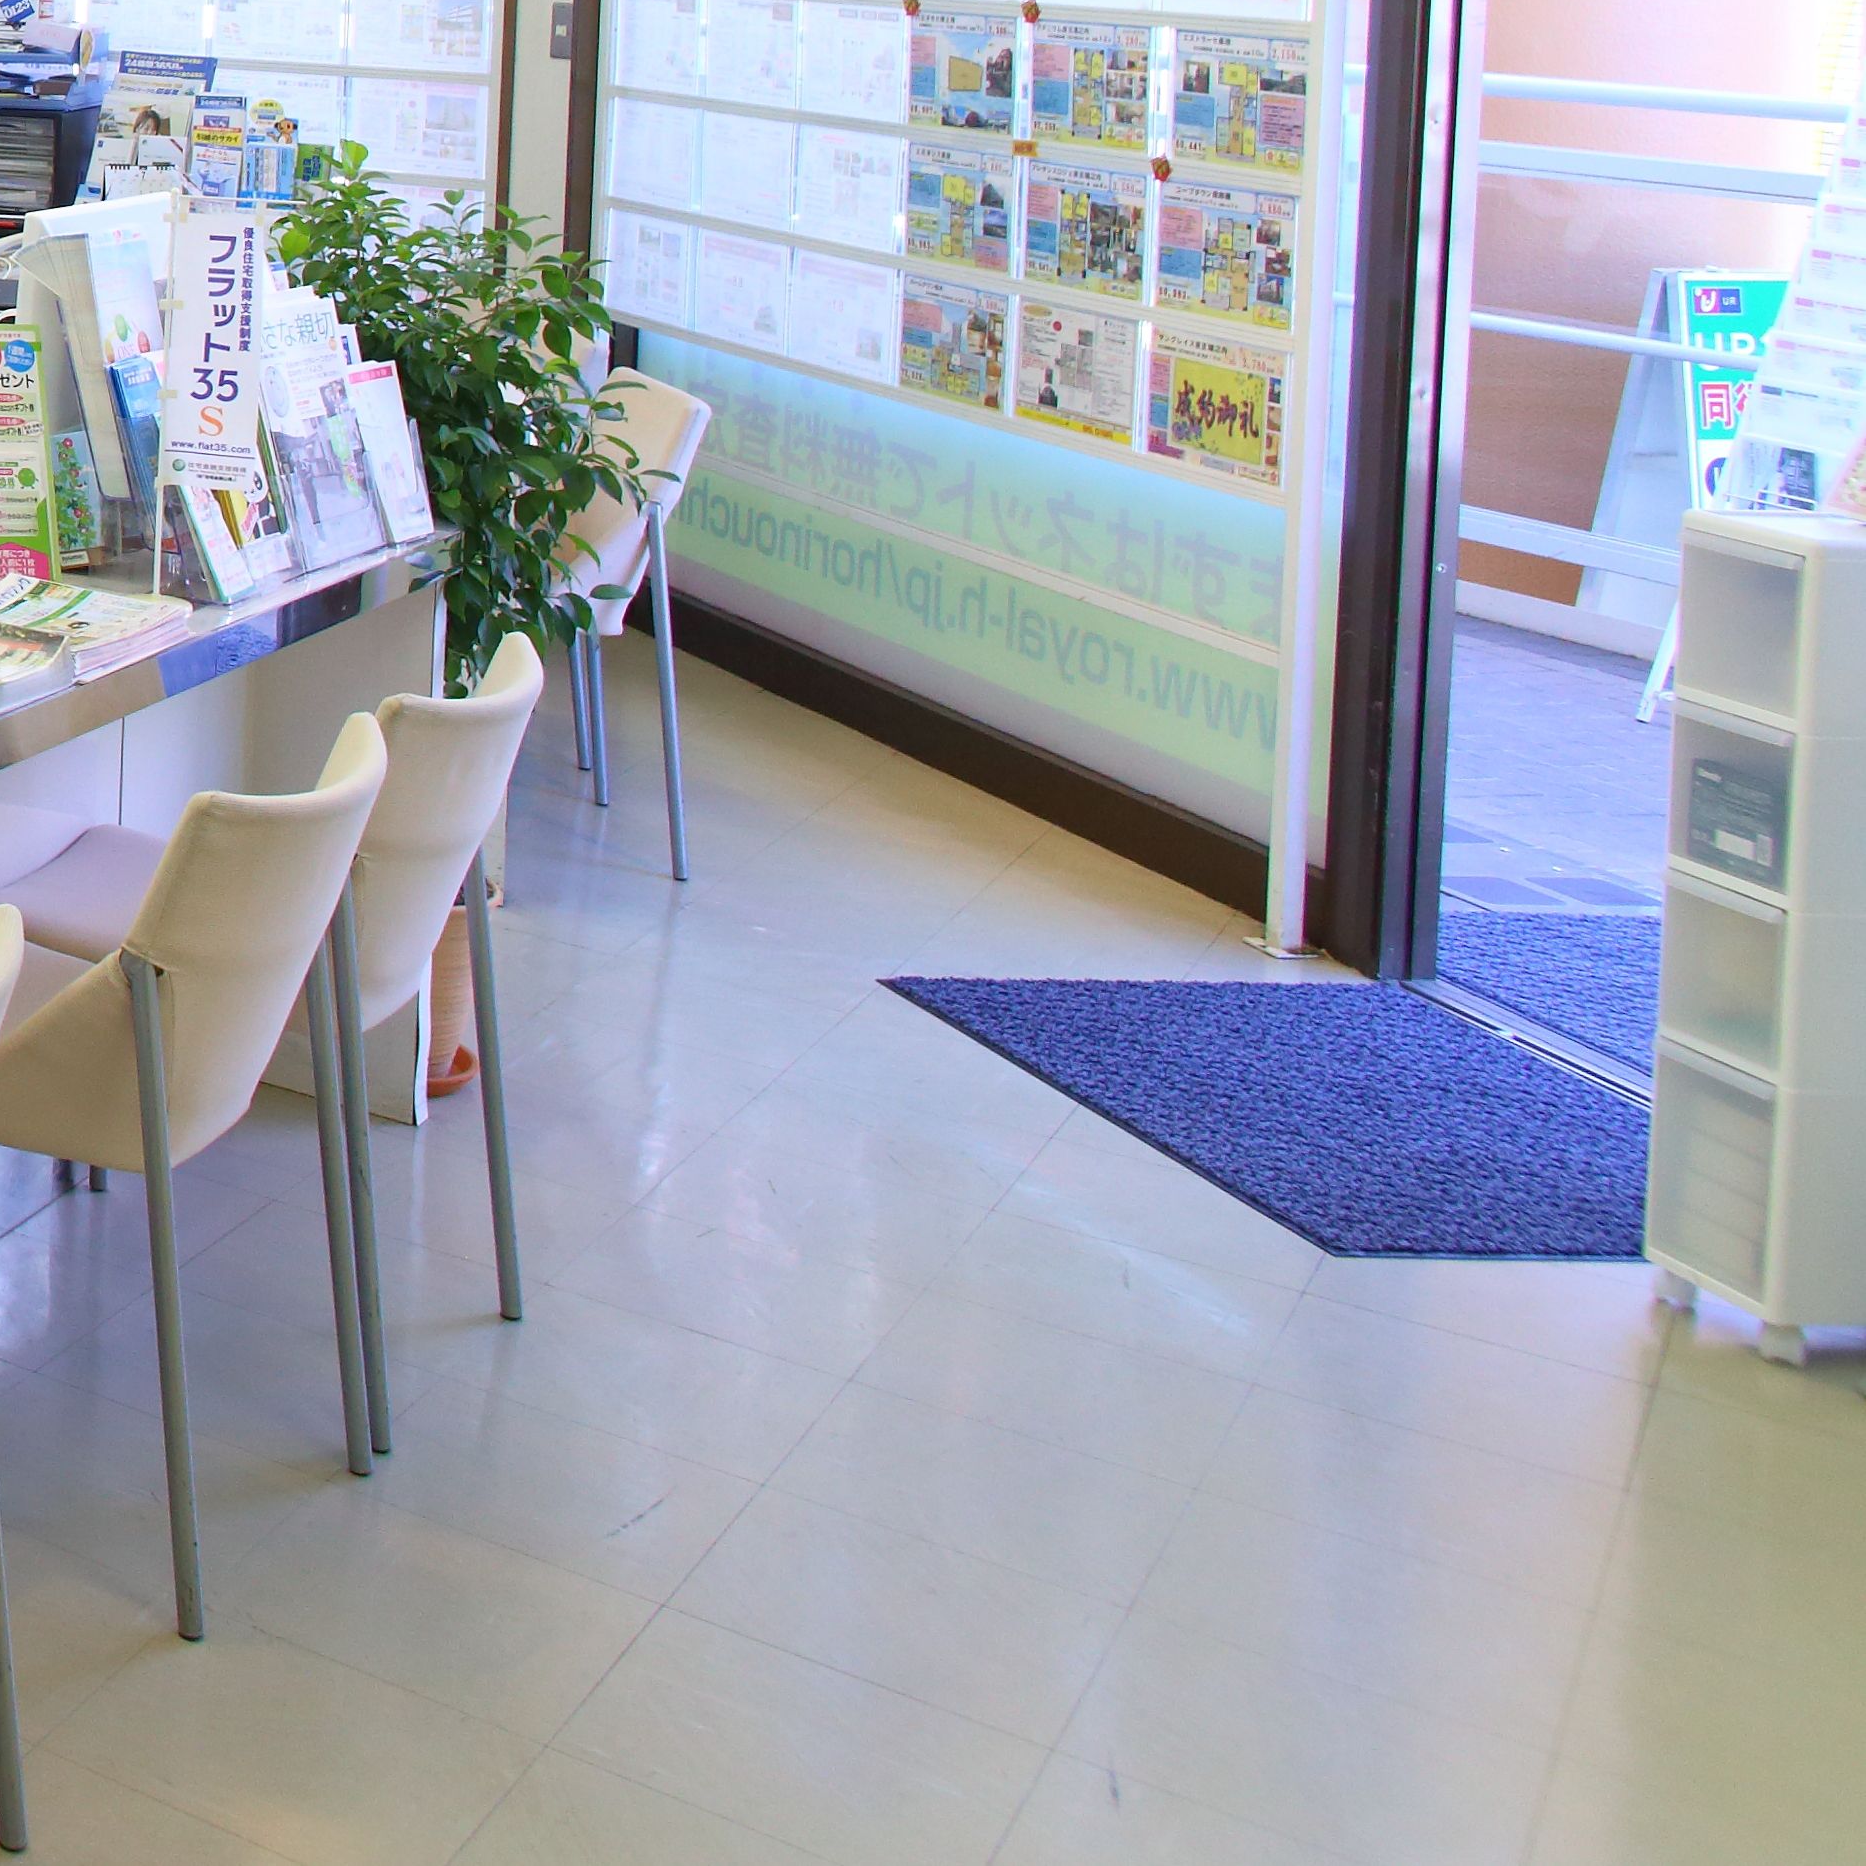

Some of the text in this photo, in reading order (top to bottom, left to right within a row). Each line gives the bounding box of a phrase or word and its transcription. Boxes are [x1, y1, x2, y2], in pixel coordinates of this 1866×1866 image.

[190, 234, 239, 437] フラット35 S
[238, 226, 255, 352] 優良住宅取得支援制度
[170, 437, 252, 455] www.flat35.com
[1173, 378, 1261, 441] 成約御礼
